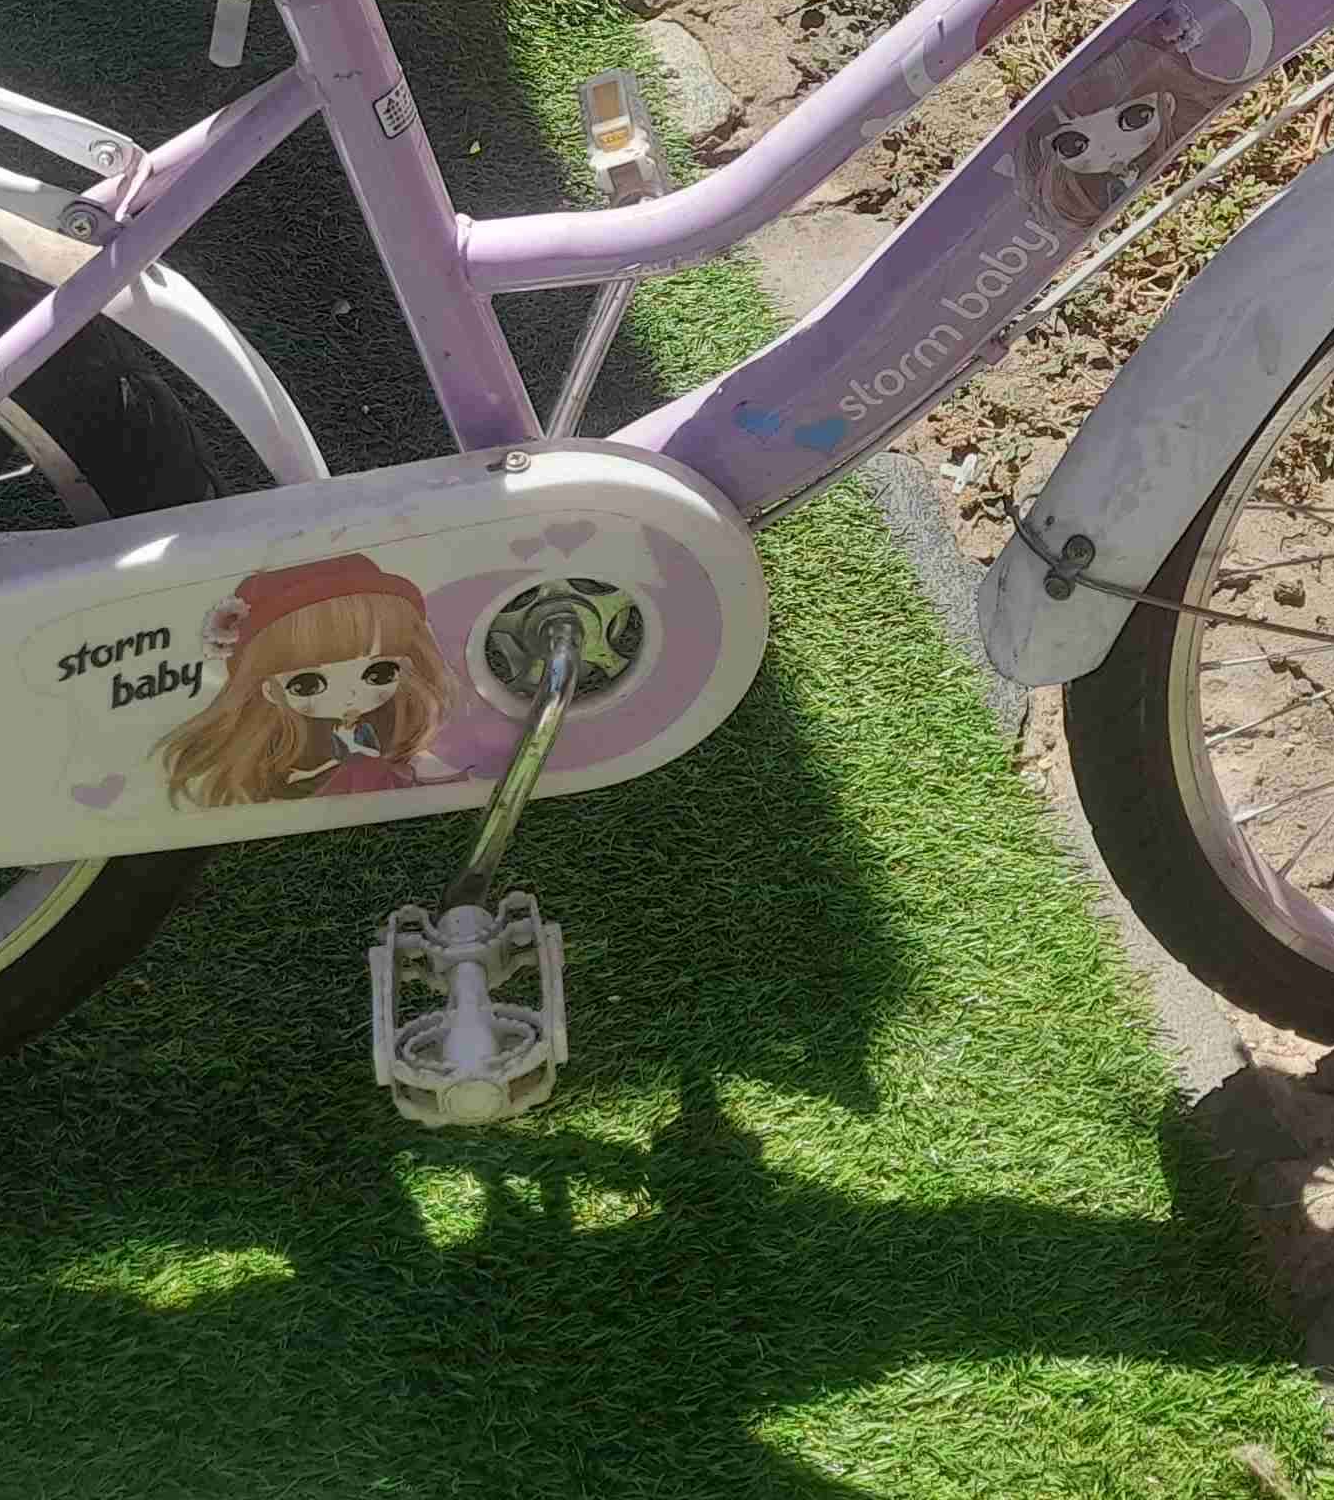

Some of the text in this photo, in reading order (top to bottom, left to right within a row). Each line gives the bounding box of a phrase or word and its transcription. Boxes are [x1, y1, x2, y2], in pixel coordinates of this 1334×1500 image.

[840, 219, 1061, 421] storm baby
[57, 626, 171, 682] storm
[111, 659, 204, 709] baby
